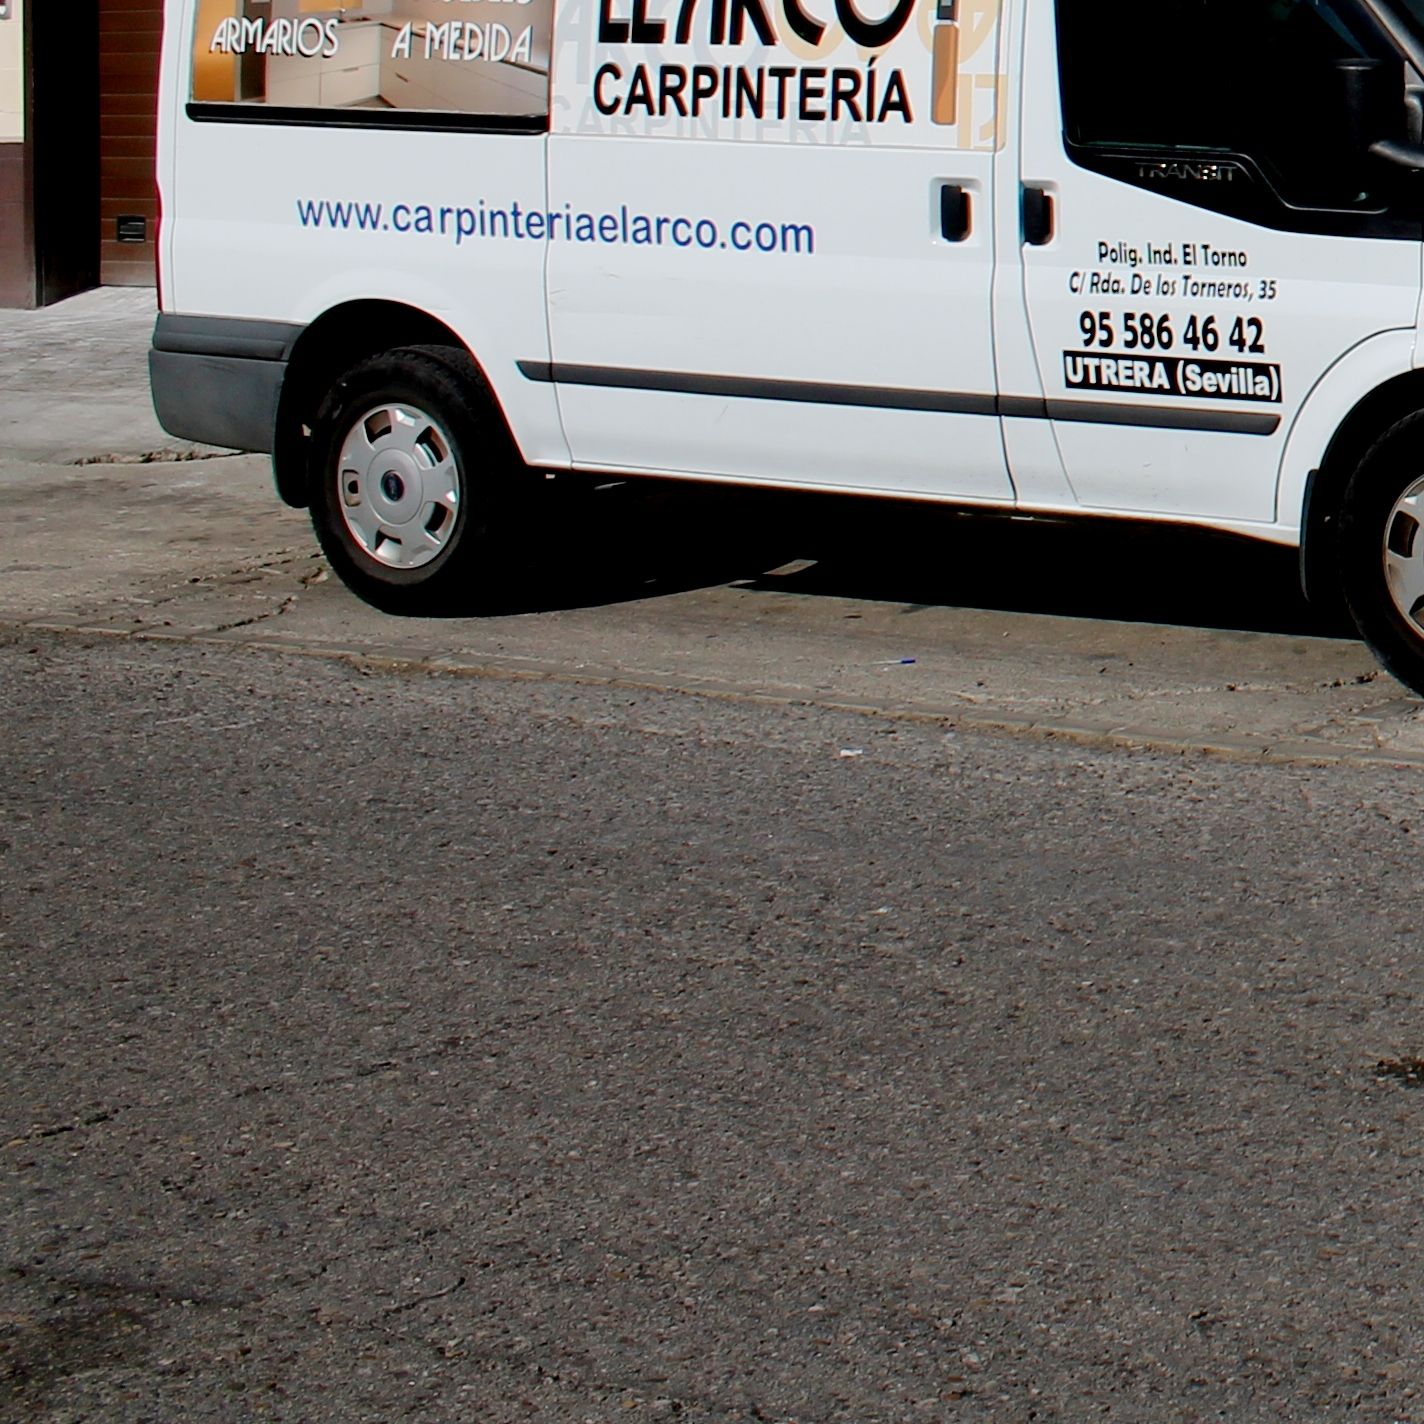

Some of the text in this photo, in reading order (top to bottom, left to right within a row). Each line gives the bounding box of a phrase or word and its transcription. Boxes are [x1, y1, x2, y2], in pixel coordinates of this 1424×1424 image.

[209, 17, 340, 57] ARMARIOS
[391, 21, 533, 62] A MEDIDA
[593, 55, 914, 124] CARPINTERÍA
[1135, 162, 1238, 182] TRANSIT
[297, 199, 815, 253] www.carpinteriaelarco.com
[1097, 241, 1247, 268] Polig. Ind. El Torno
[1069, 271, 1277, 302] C/ Rda. De los Torneros, 35
[1079, 310, 1265, 354] 95 586 46 42
[1065, 356, 1280, 401] UTRERA (Sevilla)
